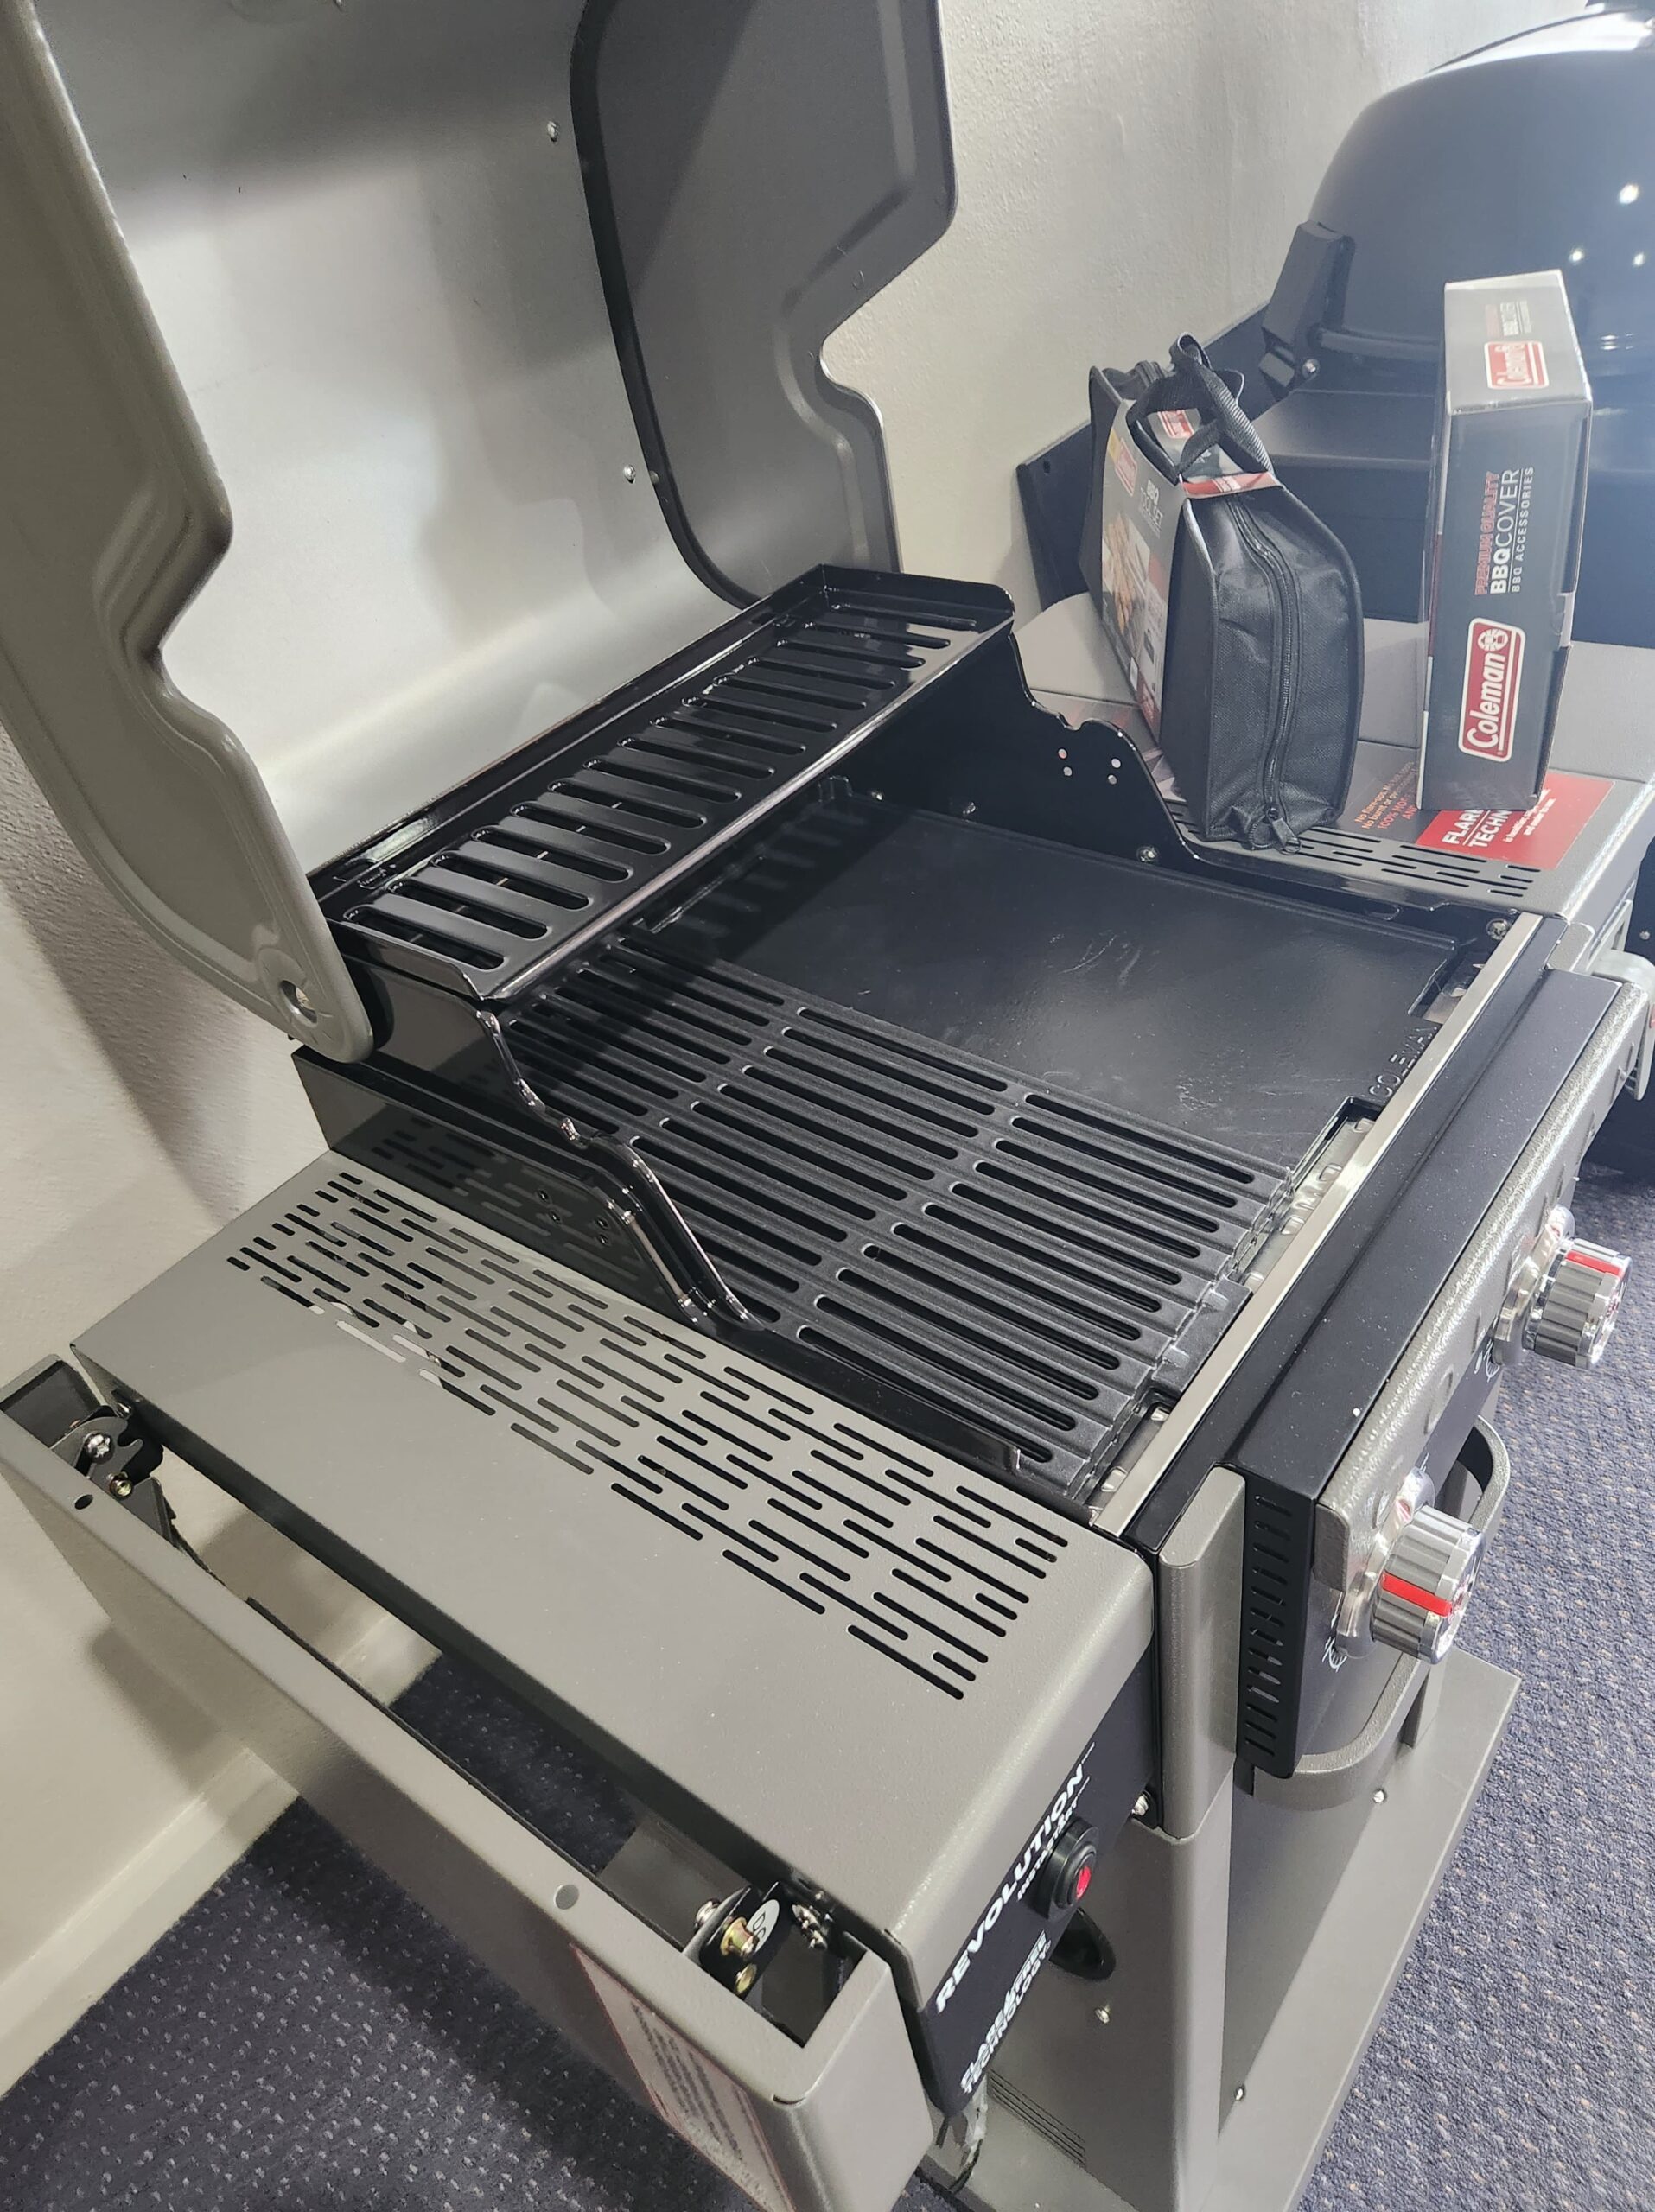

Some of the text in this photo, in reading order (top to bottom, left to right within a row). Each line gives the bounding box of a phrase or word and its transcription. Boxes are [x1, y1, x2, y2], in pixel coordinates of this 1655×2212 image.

[1474, 471, 1499, 595] PREMIUM QUALITY
[1511, 467, 1534, 593] BBQ ACCESSORIES
[1467, 652, 1506, 748] Coleman
[1354, 813, 1367, 822] No
[1361, 820, 1375, 830] No
[1378, 811, 1399, 829] 100%
[1467, 810, 1512, 847] TECHN
[936, 1763, 1083, 2014] REVOLUTION
[1018, 1796, 1078, 1901] INSTASTART
[960, 1933, 1047, 2088] FLARE FREE
[964, 1946, 1047, 2094] TECHNOLOGY
